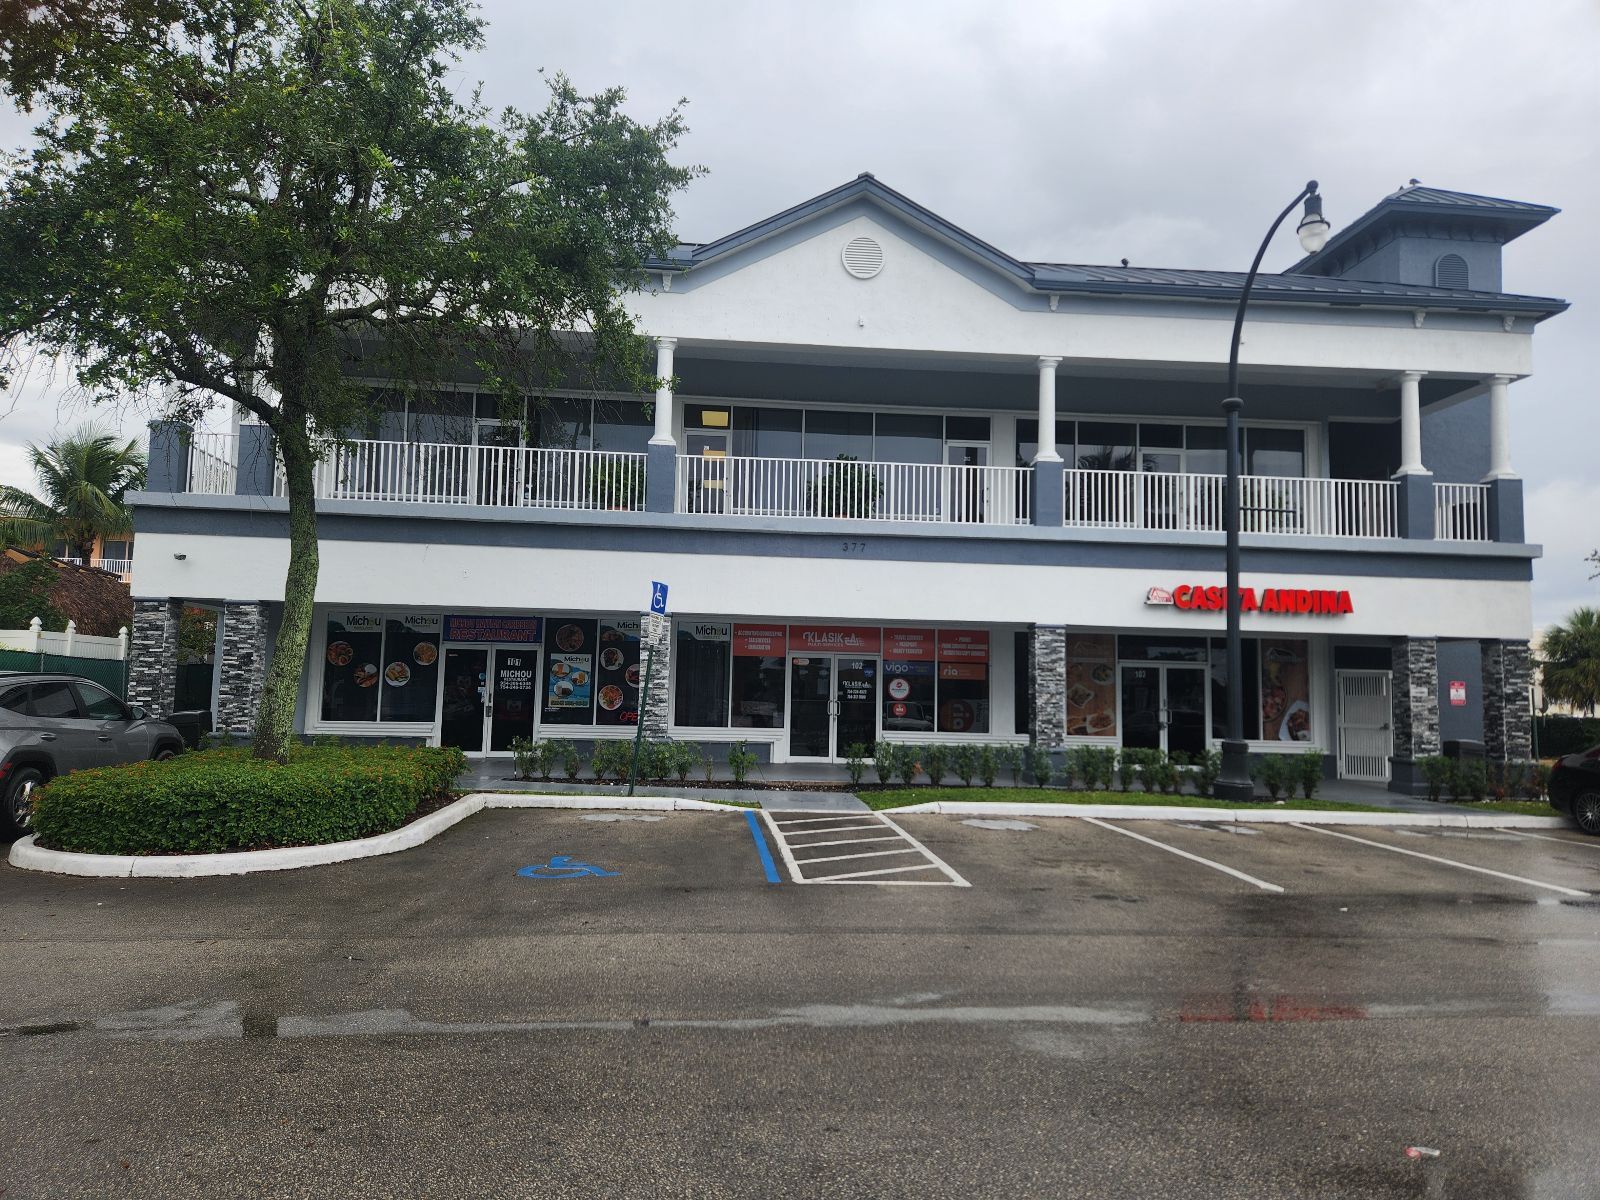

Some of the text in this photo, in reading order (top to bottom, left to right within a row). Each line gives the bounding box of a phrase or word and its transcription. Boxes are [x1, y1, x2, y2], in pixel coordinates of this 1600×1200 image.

[842, 542, 866, 552] 377
[1260, 588, 1354, 614] ANDINA
[346, 615, 382, 626] Michou
[404, 615, 439, 625] Michou
[617, 621, 639, 629] Mich
[449, 628, 537, 642] RESTAURANT
[695, 624, 728, 636] Michou
[851, 662, 864, 670] 102
[885, 662, 909, 674] vigo
[943, 665, 958, 676] ria
[500, 669, 532, 678] MICHOU
[620, 711, 638, 721] OPE
